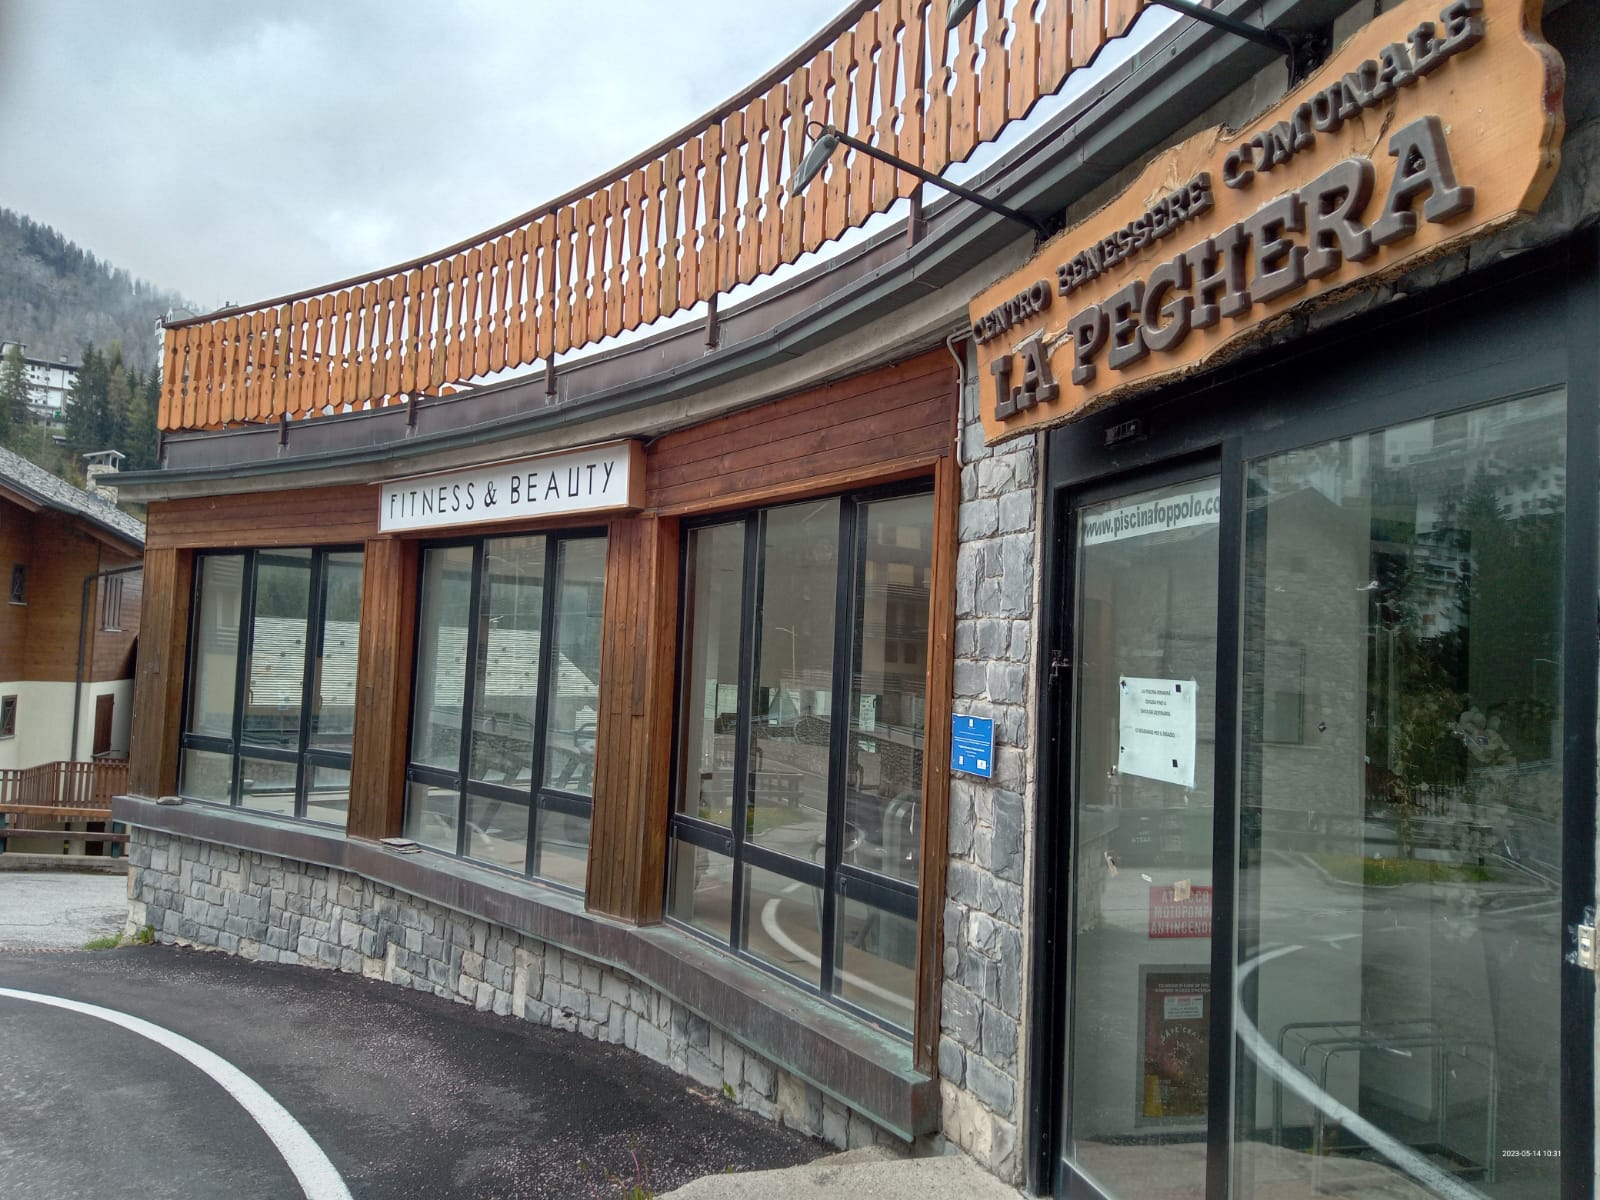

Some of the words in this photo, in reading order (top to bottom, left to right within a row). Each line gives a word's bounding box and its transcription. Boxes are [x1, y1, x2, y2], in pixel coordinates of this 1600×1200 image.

[973, 279, 1053, 345] CENTRO
[1056, 171, 1215, 297] BENESSERE
[990, 337, 1060, 421] LA
[1066, 115, 1475, 386] PEGHERA
[389, 481, 475, 519] FITNESS
[484, 480, 498, 508] &
[509, 460, 615, 505] BEAUTY
